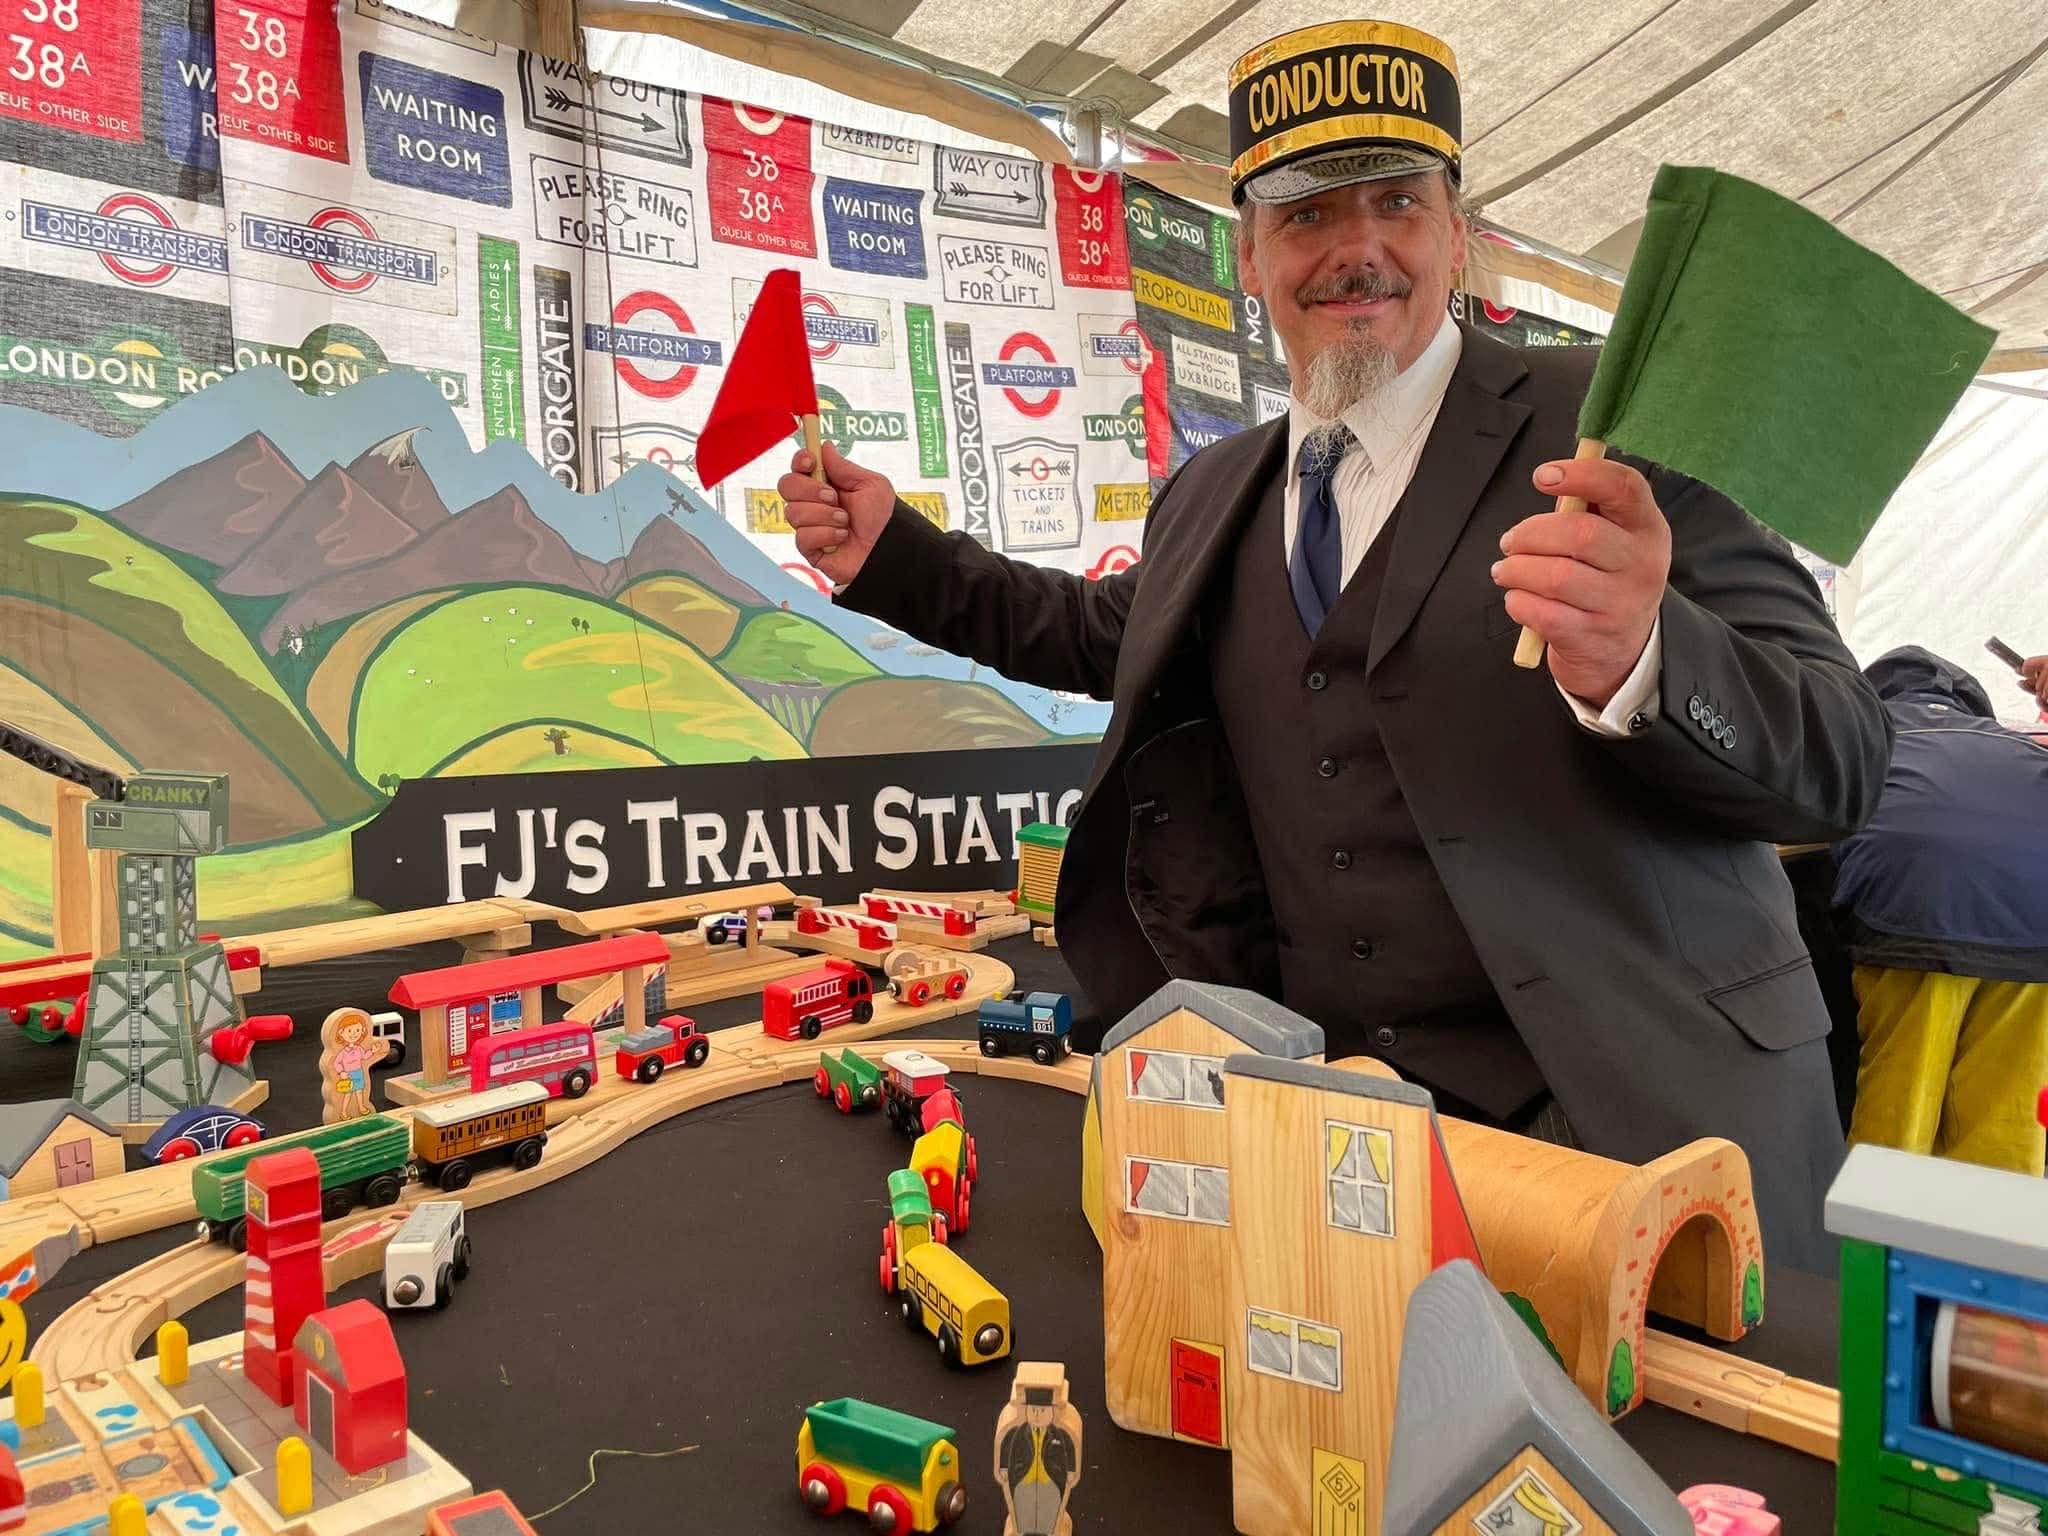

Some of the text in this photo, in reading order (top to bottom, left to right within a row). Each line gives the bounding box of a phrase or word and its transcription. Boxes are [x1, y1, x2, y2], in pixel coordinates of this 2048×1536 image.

[237, 8, 288, 59] 38
[8, 34, 91, 89] 38A
[229, 61, 302, 111] 38A
[541, 53, 666, 107] WA OUT
[1249, 53, 1427, 133] CONDUCTOR
[39, 101, 91, 125] OTHER
[96, 113, 130, 133] SIDE
[373, 85, 497, 138] WAITING
[257, 124, 303, 145] OTHER
[308, 135, 337, 154] SIDE
[398, 133, 483, 176] ROOM
[831, 125, 914, 155] UXBRIDGE
[948, 153, 1031, 183] WAY OUT
[539, 173, 689, 229] PLEASE RING
[737, 188, 785, 223] 38A
[832, 195, 914, 226] WAITING
[29, 206, 120, 243] LONDON
[1081, 204, 1104, 232] 38
[1160, 219, 1202, 244] ROAD
[249, 220, 431, 280] LONDON TRANSPORT
[559, 217, 676, 259] FOR LIFT
[720, 226, 810, 251] QUEUE OTHER SIDE
[849, 230, 907, 256] ROOM
[1078, 240, 1112, 265] 38A
[944, 245, 1046, 279] PLEASE RING
[490, 262, 500, 322] LADIES
[960, 280, 1039, 305] FOR LIFT
[1134, 273, 1229, 324] TROPOLITAN
[596, 329, 711, 361] PLATFORM 9
[811, 321, 874, 342] TRANSPORT
[913, 322, 925, 371] LADIES
[1175, 343, 1236, 369] ALL STATIONS
[1201, 362, 1213, 374] TO
[990, 367, 1069, 384] PLATFORM 9
[1178, 367, 1238, 394] UXBRIDGE
[846, 415, 902, 436] ROAD
[921, 397, 934, 471] GENTLEMEN
[950, 347, 989, 535] MOORGATE
[1012, 487, 1065, 503] TICKETS
[1034, 505, 1051, 516] AND
[1021, 519, 1065, 535] TRAINS
[128, 784, 208, 805] CRANKY
[627, 797, 855, 888] TRAIN
[1037, 1023, 1052, 1032] 001
[1335, 1477, 1342, 1492] 5
